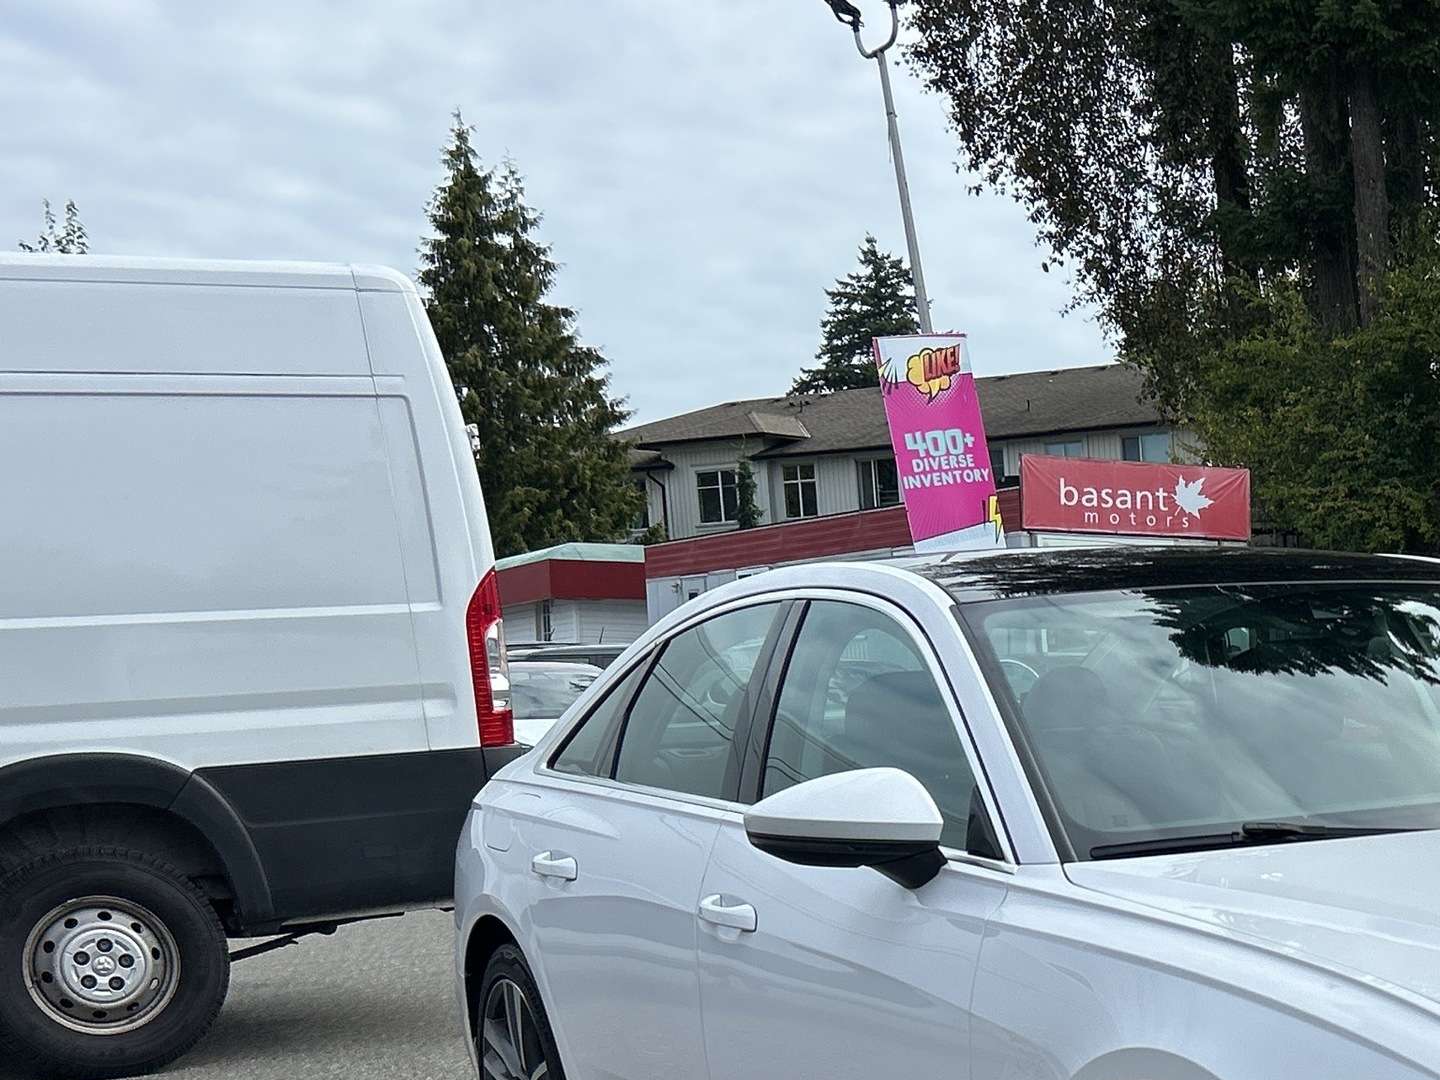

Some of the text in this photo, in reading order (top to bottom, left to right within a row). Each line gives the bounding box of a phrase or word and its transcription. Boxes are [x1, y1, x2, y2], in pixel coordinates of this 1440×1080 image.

[923, 345, 960, 381] LIKE!
[904, 428, 975, 457] 400+
[911, 454, 975, 473] DIVERSE
[903, 468, 989, 489] INVENTORY
[1059, 478, 1169, 511] basant
[1084, 512, 1189, 528] motors
